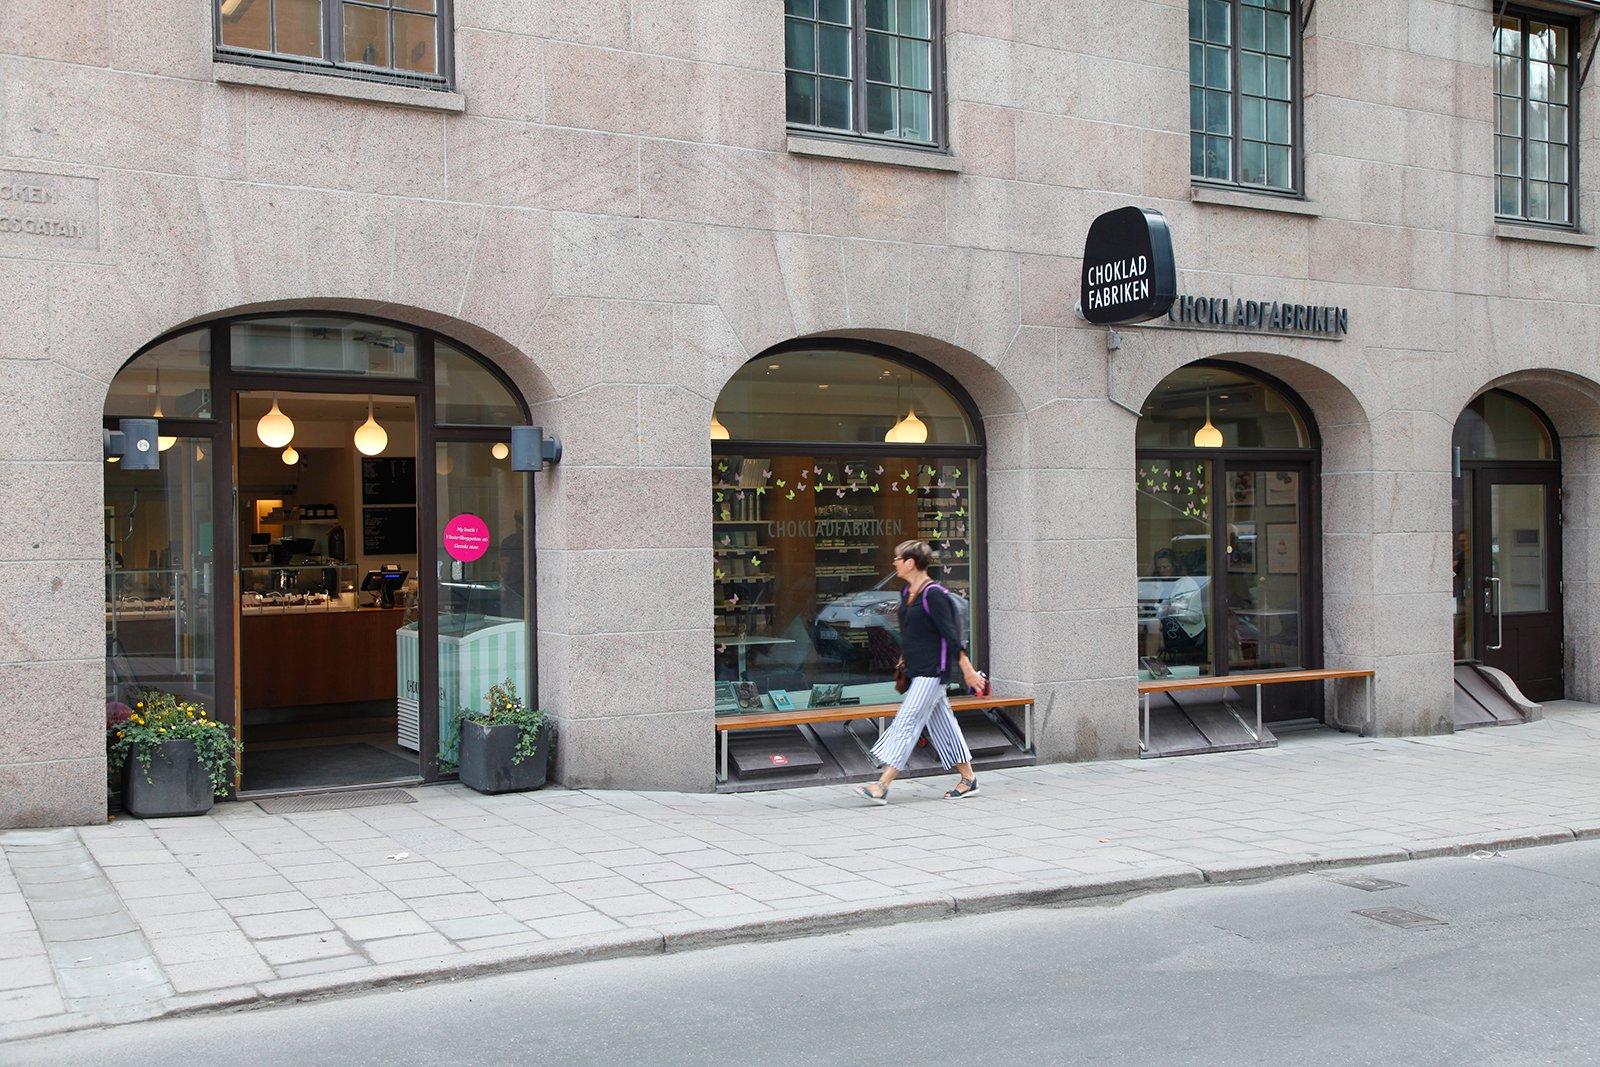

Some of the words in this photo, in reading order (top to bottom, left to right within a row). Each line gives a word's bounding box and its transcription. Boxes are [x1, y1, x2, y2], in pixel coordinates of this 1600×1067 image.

[1088, 255, 1147, 287] CHOKLAD
[1088, 278, 1149, 310] FABRIKEN
[767, 520, 903, 538] CHOKLADFABRIKEN
